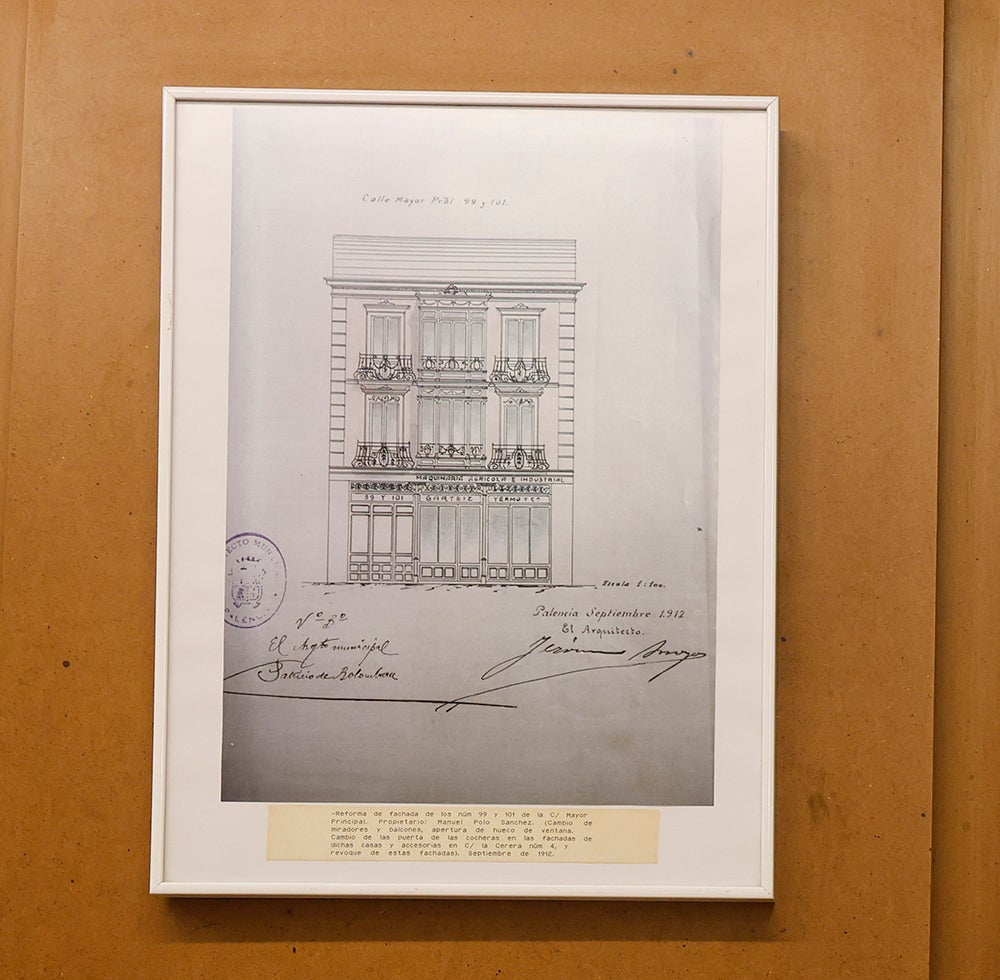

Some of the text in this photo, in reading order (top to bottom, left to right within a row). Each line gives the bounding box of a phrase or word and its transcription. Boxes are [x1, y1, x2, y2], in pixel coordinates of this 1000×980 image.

[362, 193, 391, 203] Calle
[394, 196, 424, 207] Mayor
[532, 604, 578, 618] Palencia
[586, 605, 651, 622] Septiembre
[561, 623, 573, 634] El
